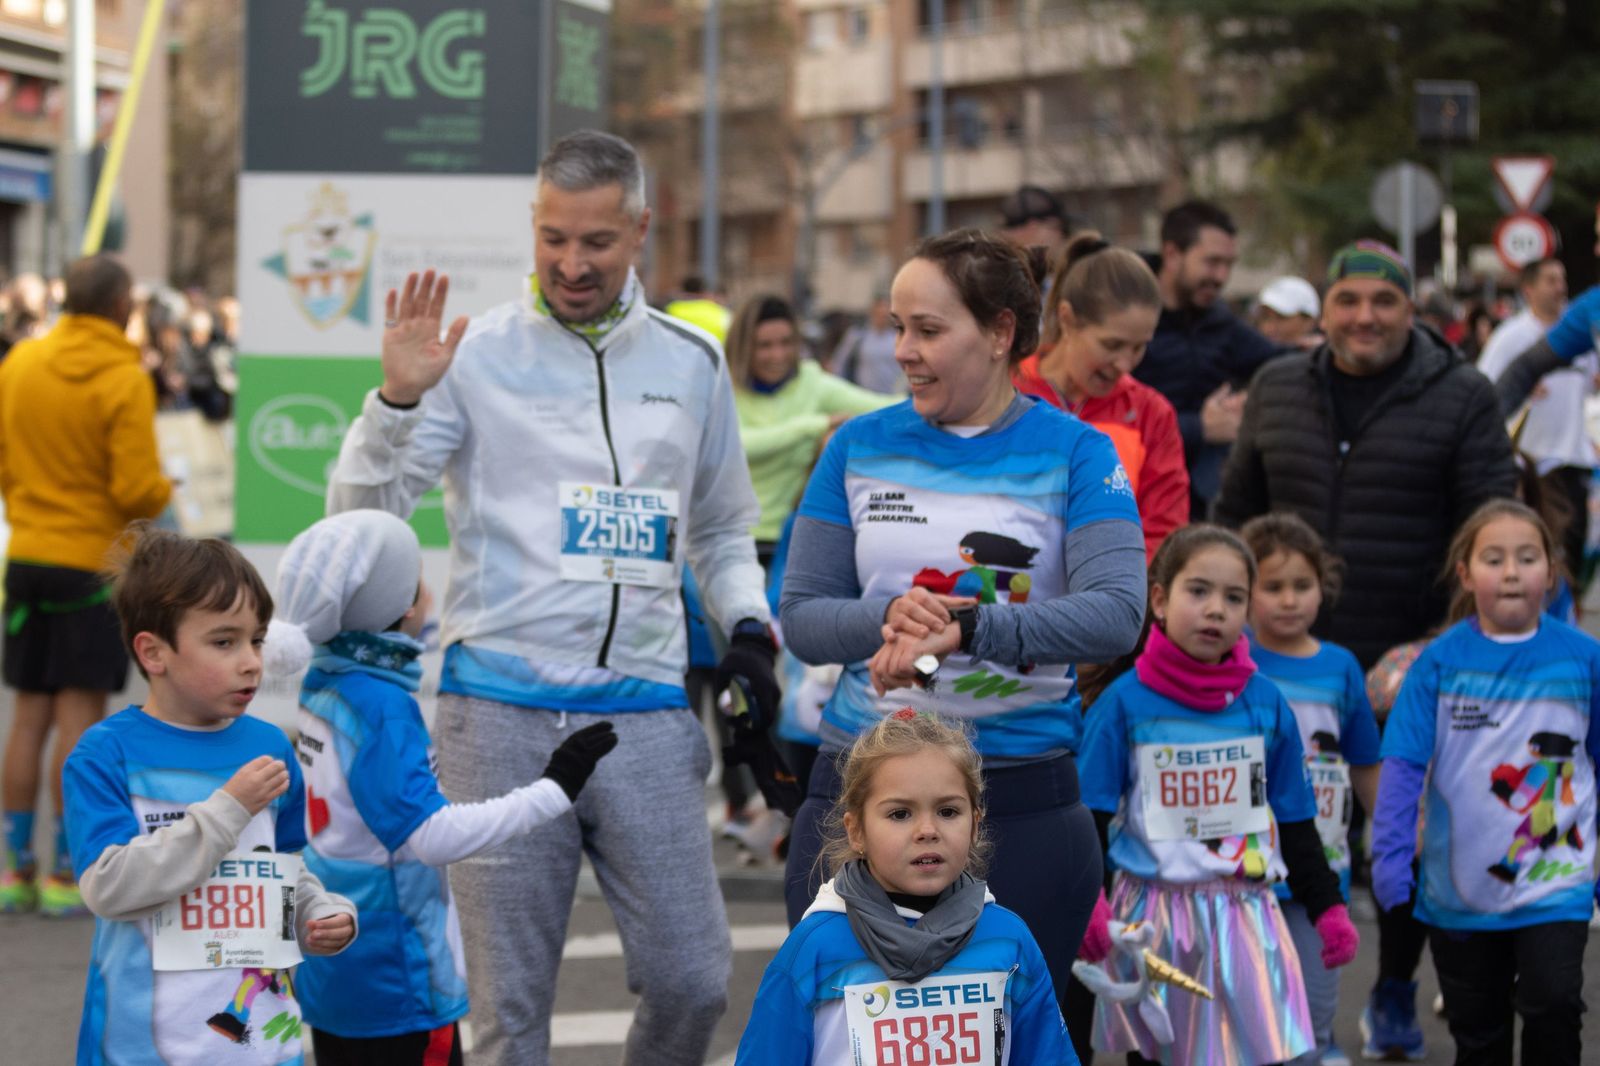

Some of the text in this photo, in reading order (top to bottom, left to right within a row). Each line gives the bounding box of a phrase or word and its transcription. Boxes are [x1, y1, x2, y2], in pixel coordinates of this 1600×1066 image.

[301, 8, 485, 98] JRG
[596, 490, 668, 511] SETEL
[885, 492, 905, 501] SAN
[868, 514, 928, 524] SALMANTINA
[576, 509, 655, 553] 2505
[1177, 745, 1252, 765] SETEL
[1160, 767, 1237, 807] 6662
[162, 811, 185, 821] SAN
[180, 885, 265, 930] 6881
[214, 930, 240, 940] ALEX
[895, 983, 996, 1009] SETEL
[873, 1012, 981, 1066] 6835
